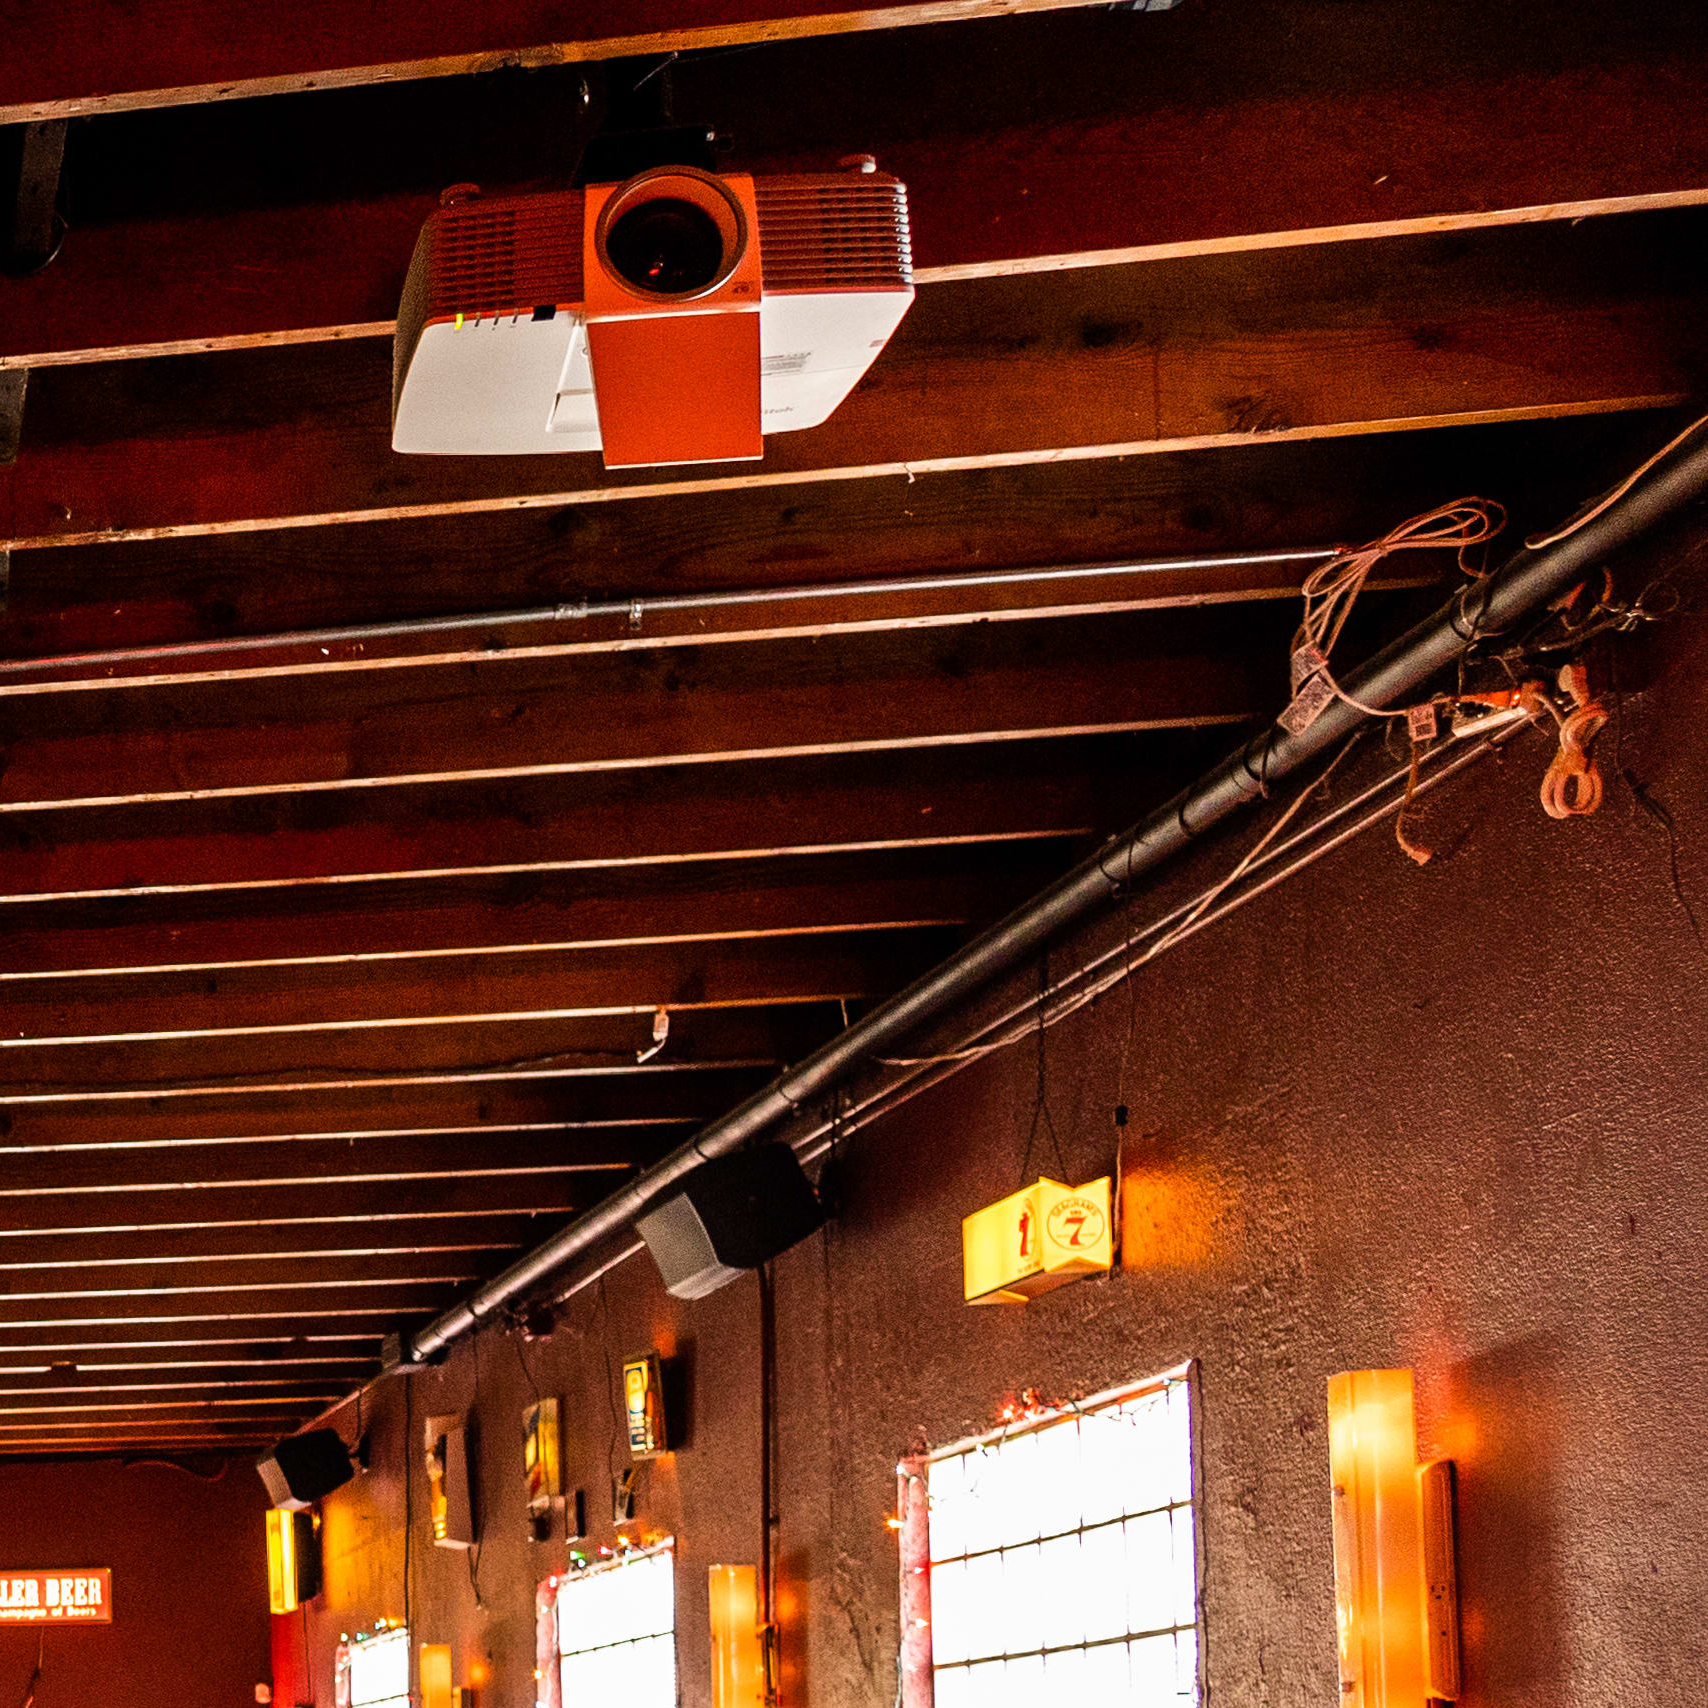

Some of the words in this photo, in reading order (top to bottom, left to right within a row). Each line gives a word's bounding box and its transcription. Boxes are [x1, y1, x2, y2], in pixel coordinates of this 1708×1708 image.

[1064, 1216, 1088, 1246] 7
[45, 1578, 103, 1607] BEER
[51, 1607, 63, 1617] of
[67, 1606, 97, 1618] Beers
